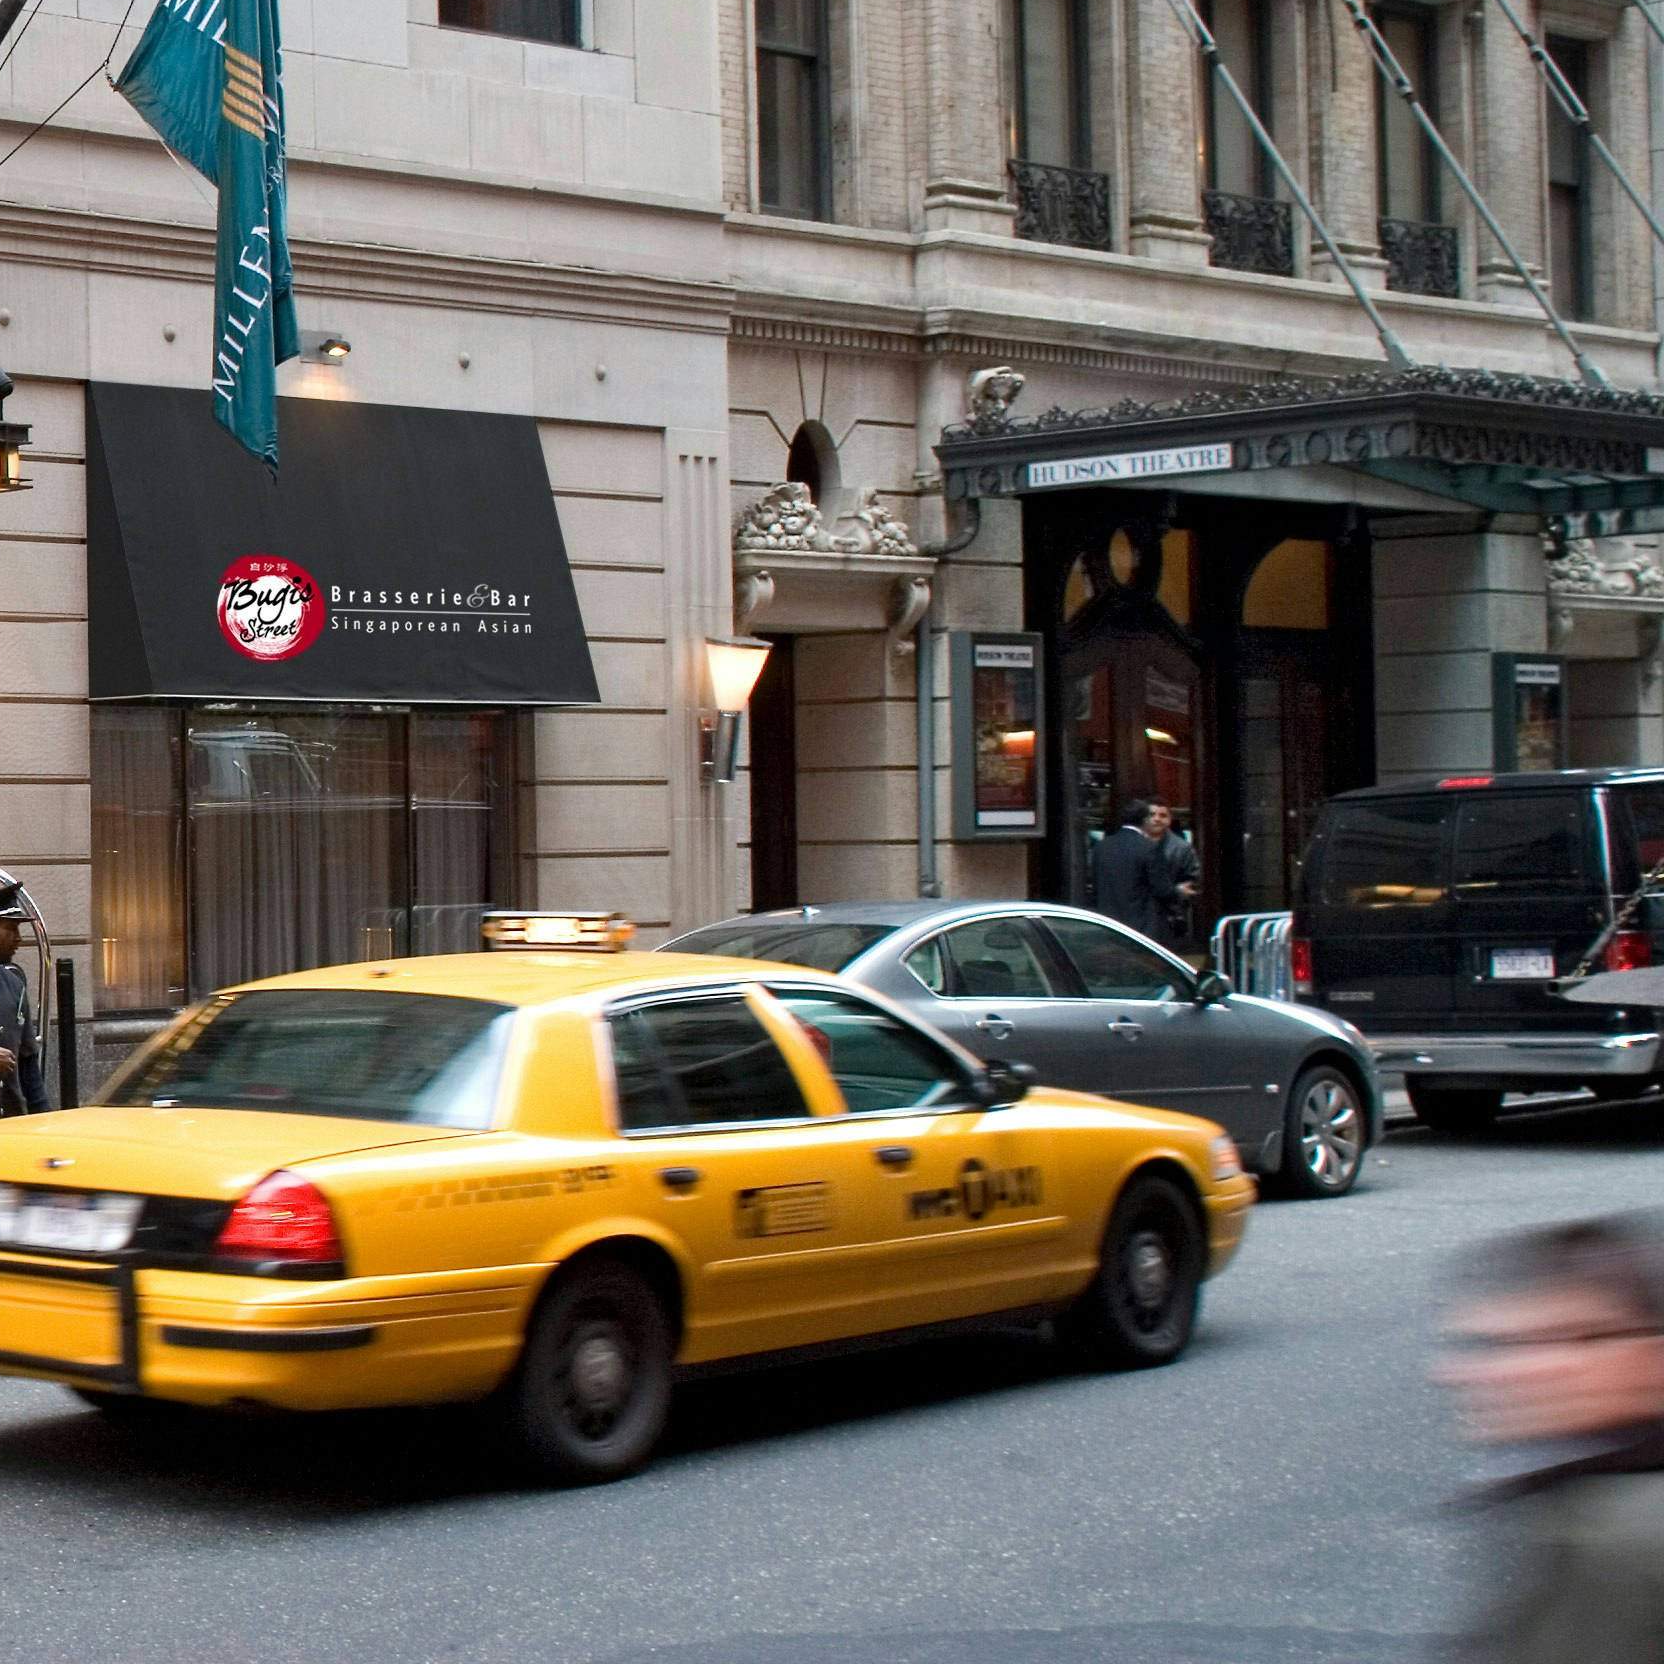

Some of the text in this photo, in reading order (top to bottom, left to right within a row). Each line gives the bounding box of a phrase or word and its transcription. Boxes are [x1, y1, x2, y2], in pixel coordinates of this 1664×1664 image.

[1033, 446, 1229, 484] HUDSON THEATRE
[223, 576, 315, 625] Bugis
[240, 618, 297, 643] Street
[331, 615, 532, 635] Singaporean Asian
